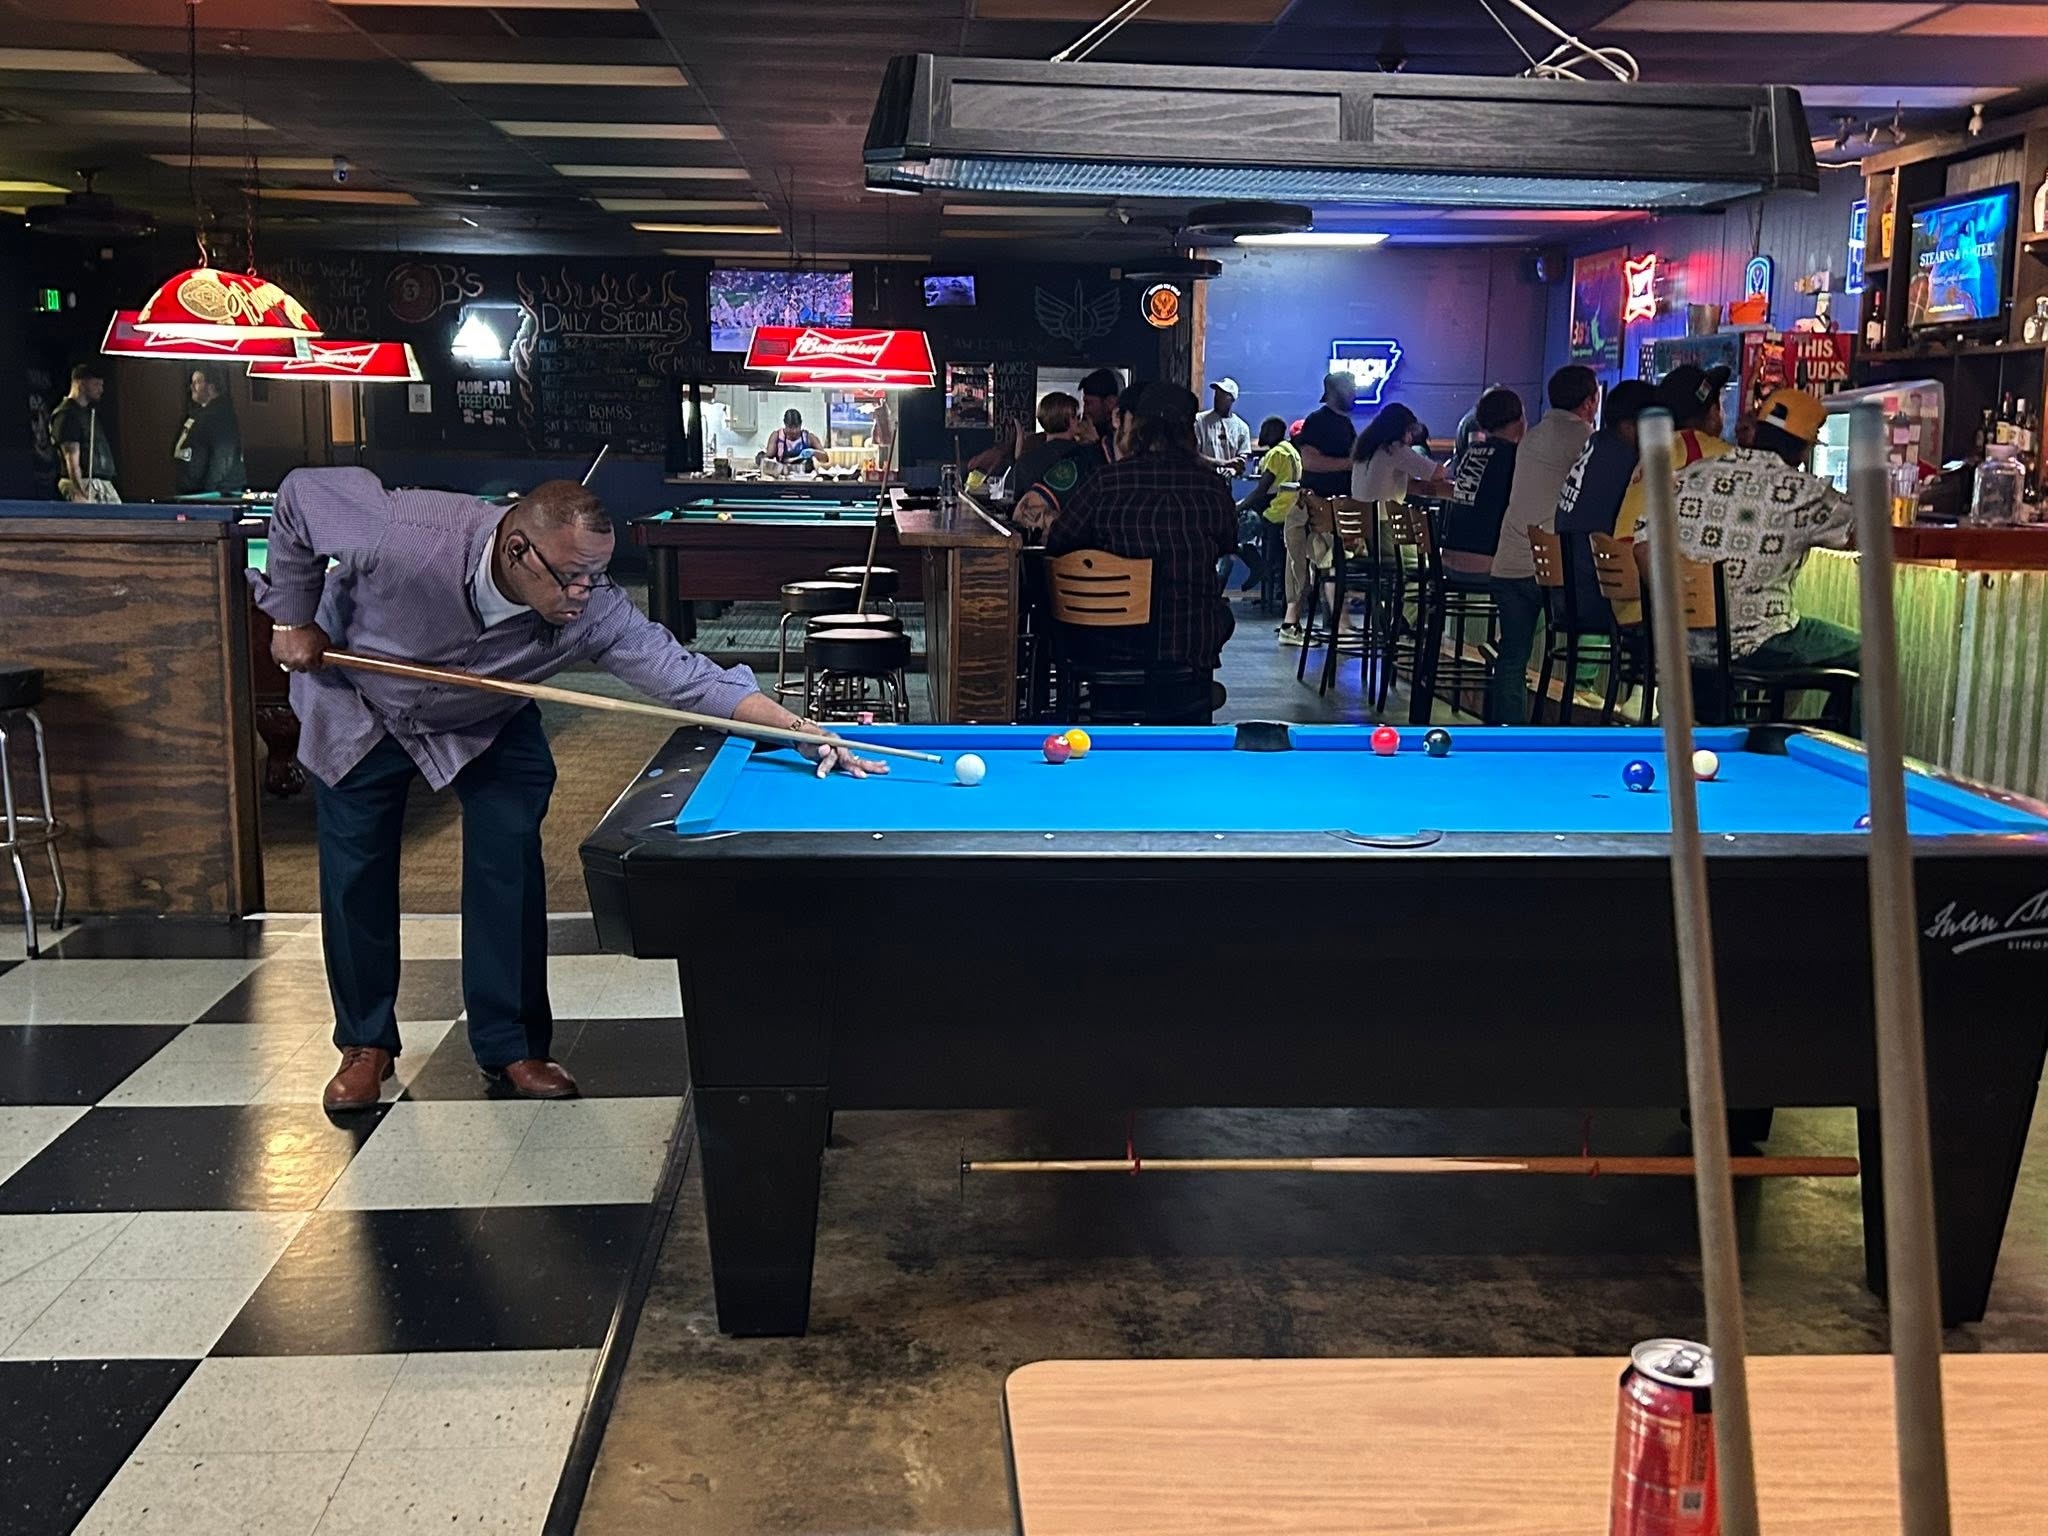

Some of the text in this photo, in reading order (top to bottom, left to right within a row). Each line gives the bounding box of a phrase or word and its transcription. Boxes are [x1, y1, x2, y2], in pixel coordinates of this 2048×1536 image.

[1919, 248, 1955, 267] STEARNS
[795, 336, 881, 356] Budweiser
[1796, 334, 1834, 358] THIS
[1793, 361, 1848, 379] UD'S
